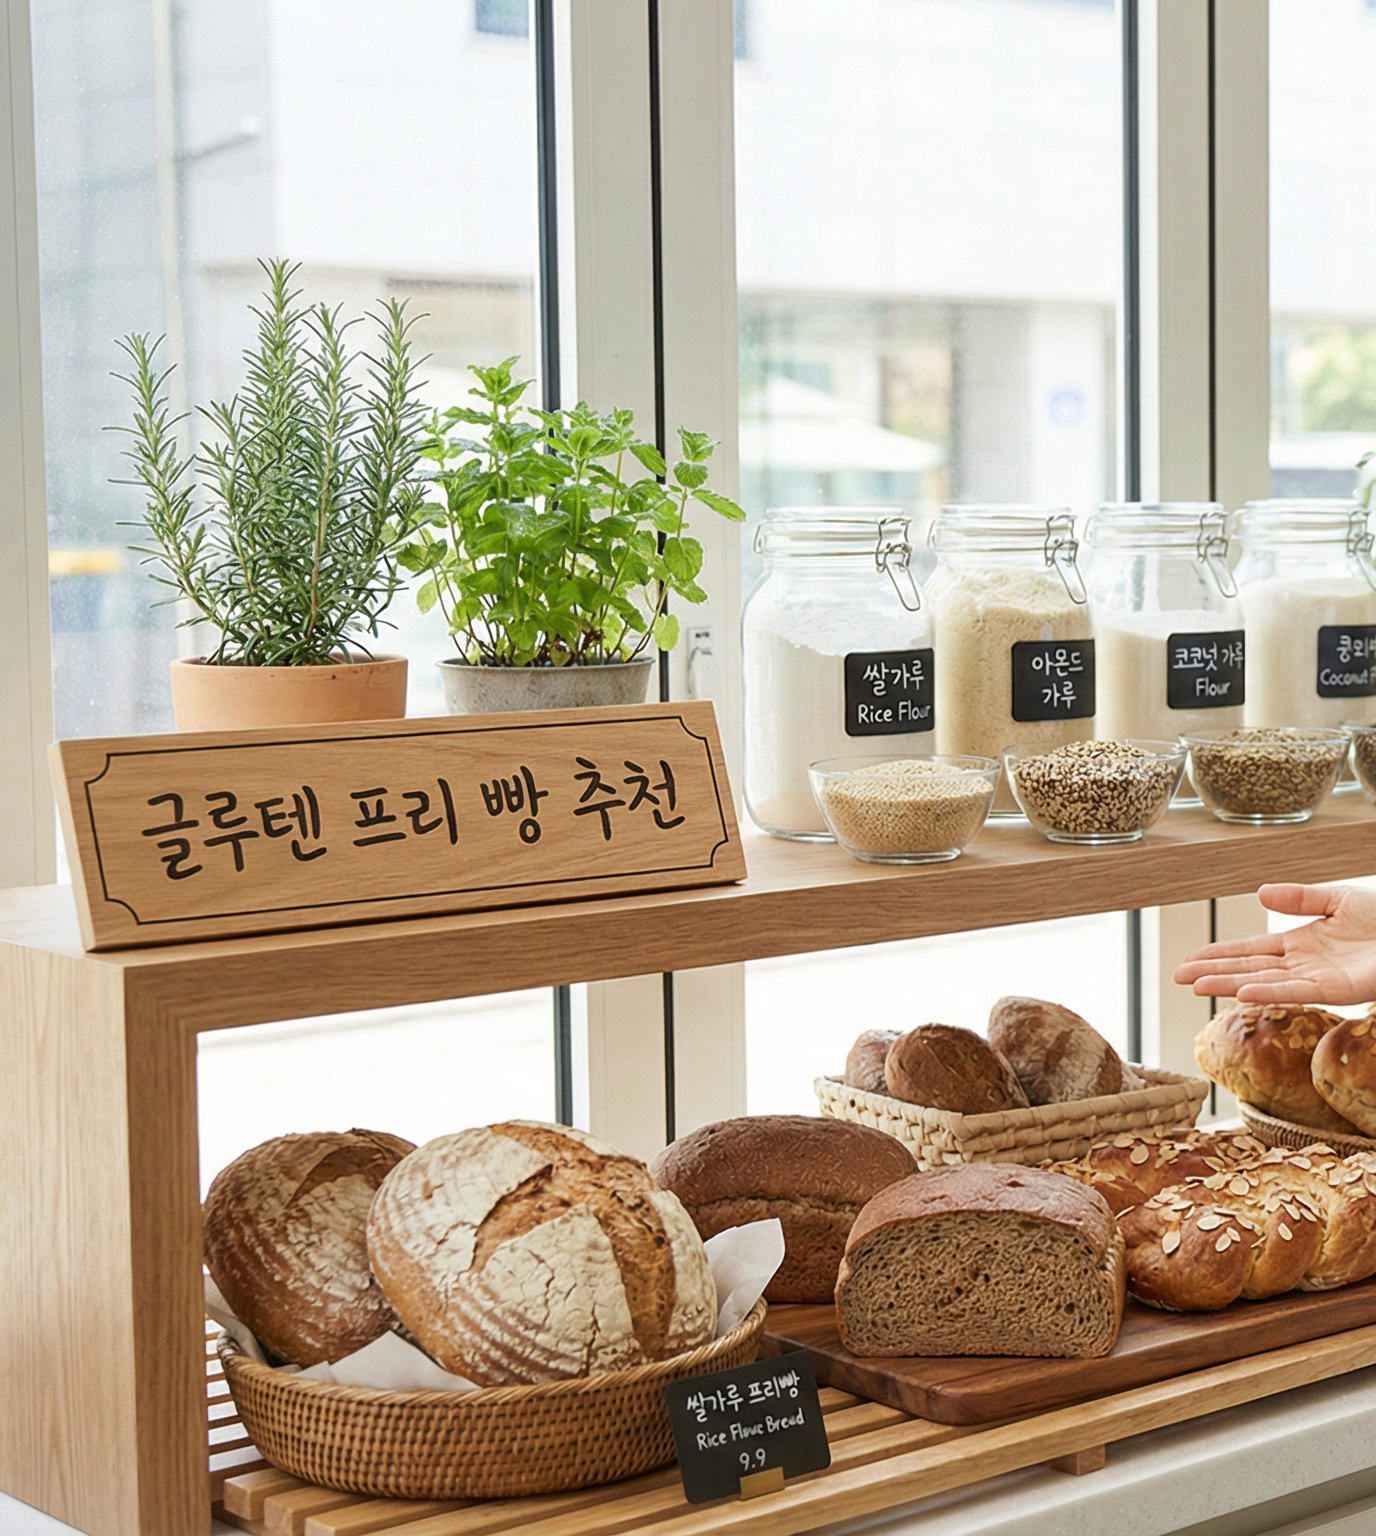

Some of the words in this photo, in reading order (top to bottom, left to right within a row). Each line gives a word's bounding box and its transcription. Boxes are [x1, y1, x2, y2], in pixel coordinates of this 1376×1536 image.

[1172, 641, 1218, 671] 코코넛
[1221, 641, 1244, 670] 가루
[862, 659, 925, 696] 쌀가루
[1195, 676, 1231, 697] Flour
[1041, 681, 1077, 709] 가루
[857, 703, 893, 724] Rice
[141, 784, 327, 880] 글루텐
[349, 777, 459, 847] 프리
[479, 764, 549, 845] 빵
[572, 756, 686, 842] 추천
[686, 1383, 744, 1422] 쌀가루
[747, 1369, 800, 1404] 프리빵
[696, 1432, 728, 1451] Rice
[739, 1448, 766, 1471] 9.9
